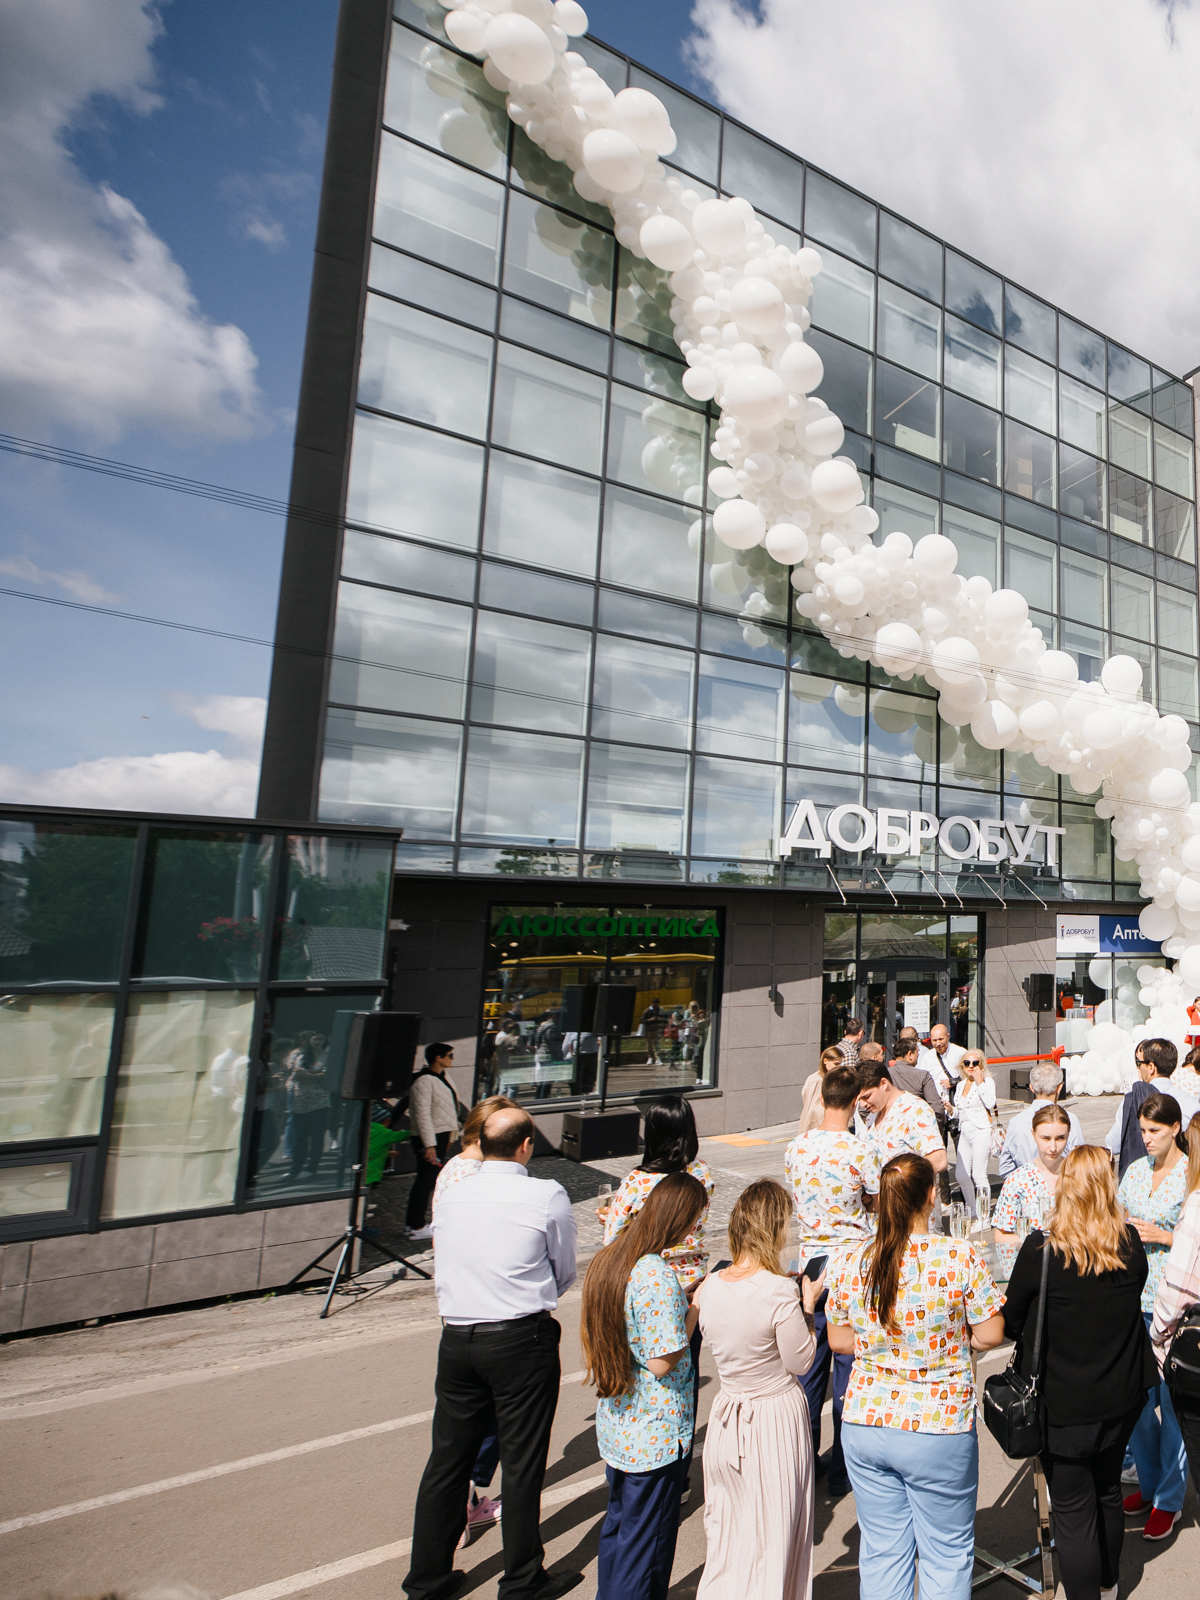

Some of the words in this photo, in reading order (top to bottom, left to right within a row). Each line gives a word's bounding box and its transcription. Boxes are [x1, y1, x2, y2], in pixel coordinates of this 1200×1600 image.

[779, 798, 1066, 866] ДОБРОБУТ
[495, 915, 720, 937] ЛЮКСОПТИКА
[1112, 923, 1147, 940] Апте
